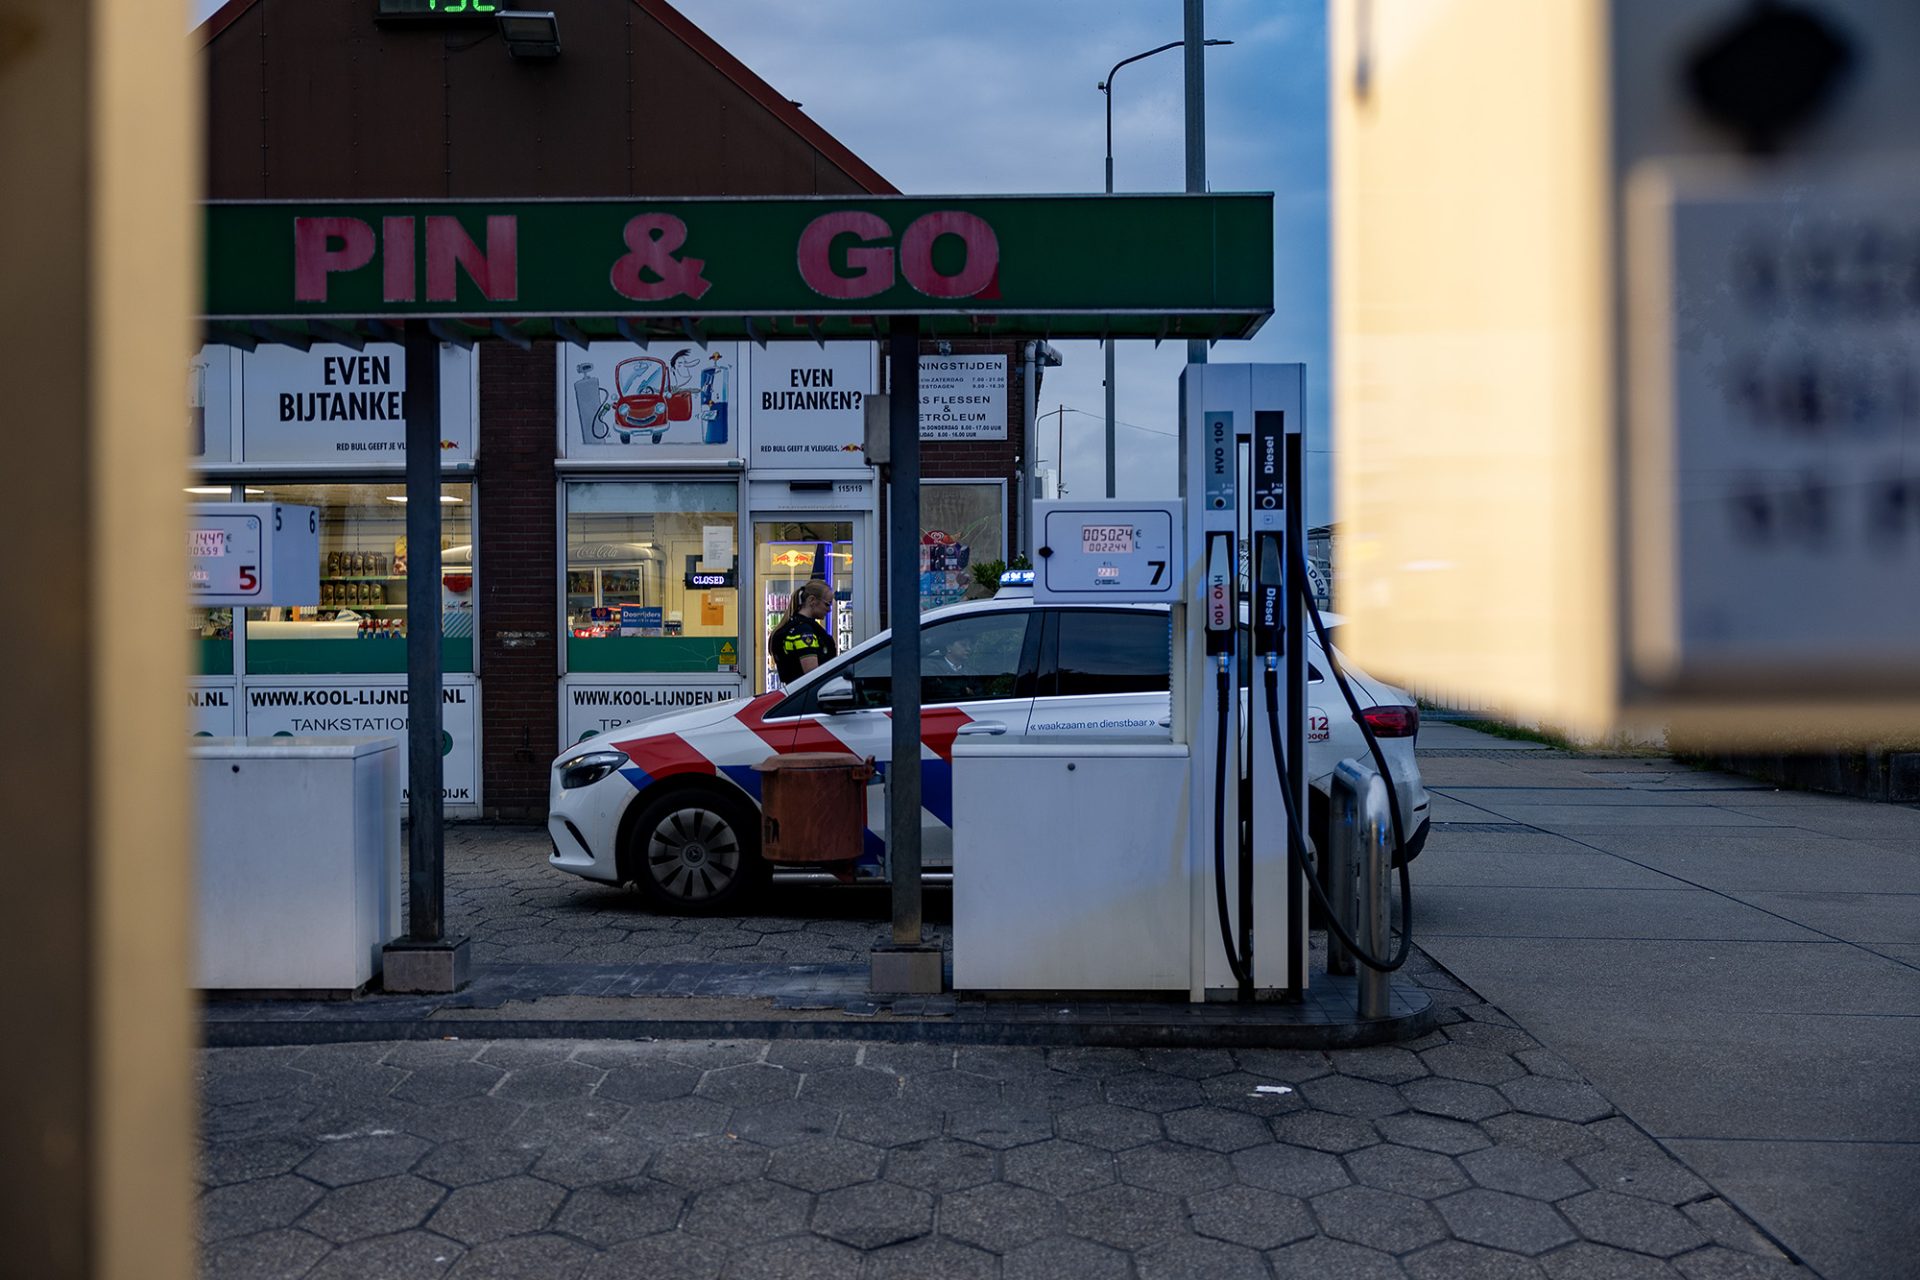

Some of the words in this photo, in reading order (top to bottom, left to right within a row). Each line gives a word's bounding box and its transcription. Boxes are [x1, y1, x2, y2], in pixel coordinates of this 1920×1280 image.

[293, 215, 518, 303] PIN
[609, 212, 712, 302] &
[798, 210, 1000, 300] GO
[324, 356, 390, 385] EVEN
[790, 368, 833, 387] EVEN
[280, 391, 406, 421] BIJTANKE
[762, 391, 862, 410] BIJTANKEN?
[933, 396, 990, 404] FLESSEN
[1215, 421, 1224, 443] 100
[337, 442, 349, 450] RED
[351, 442, 367, 450] BULL
[368, 442, 387, 450] GEEFT
[389, 442, 396, 450] JE
[1264, 436, 1274, 474] Diesel
[1215, 447, 1224, 474] HVO
[275, 507, 282, 531] 5
[310, 510, 316, 534] 6
[226, 533, 232, 542] €
[1136, 529, 1142, 538] €
[225, 545, 231, 553] L
[1135, 541, 1141, 549] L
[239, 566, 257, 590] 5
[693, 576, 725, 584] CLOSED
[1147, 561, 1166, 585] 7
[1214, 574, 1223, 600] HVO
[1214, 605, 1224, 625] 100
[1265, 588, 1276, 626] Diesel
[1037, 720, 1086, 731] waakzaam
[1099, 718, 1148, 729] dienstbaar
